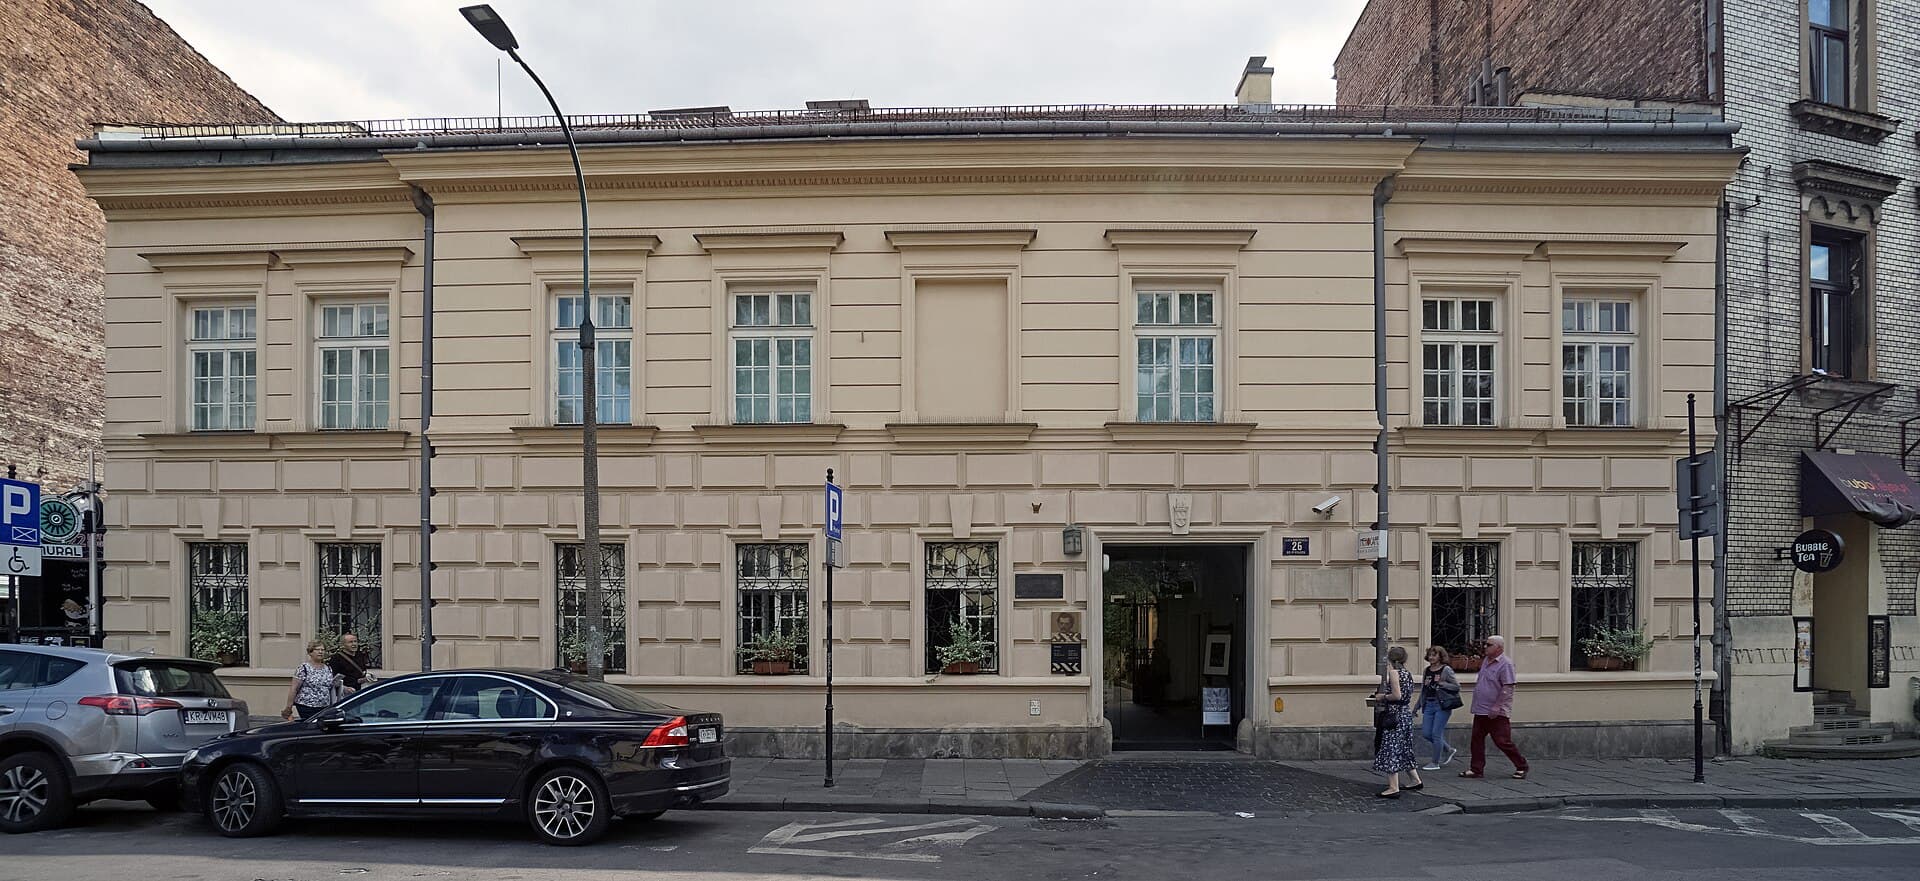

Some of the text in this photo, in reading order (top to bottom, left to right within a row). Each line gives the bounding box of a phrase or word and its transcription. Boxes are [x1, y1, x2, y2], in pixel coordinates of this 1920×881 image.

[3, 484, 31, 524] P
[829, 489, 839, 531] P
[1291, 541, 1303, 551] 26
[189, 711, 201, 721] KR
